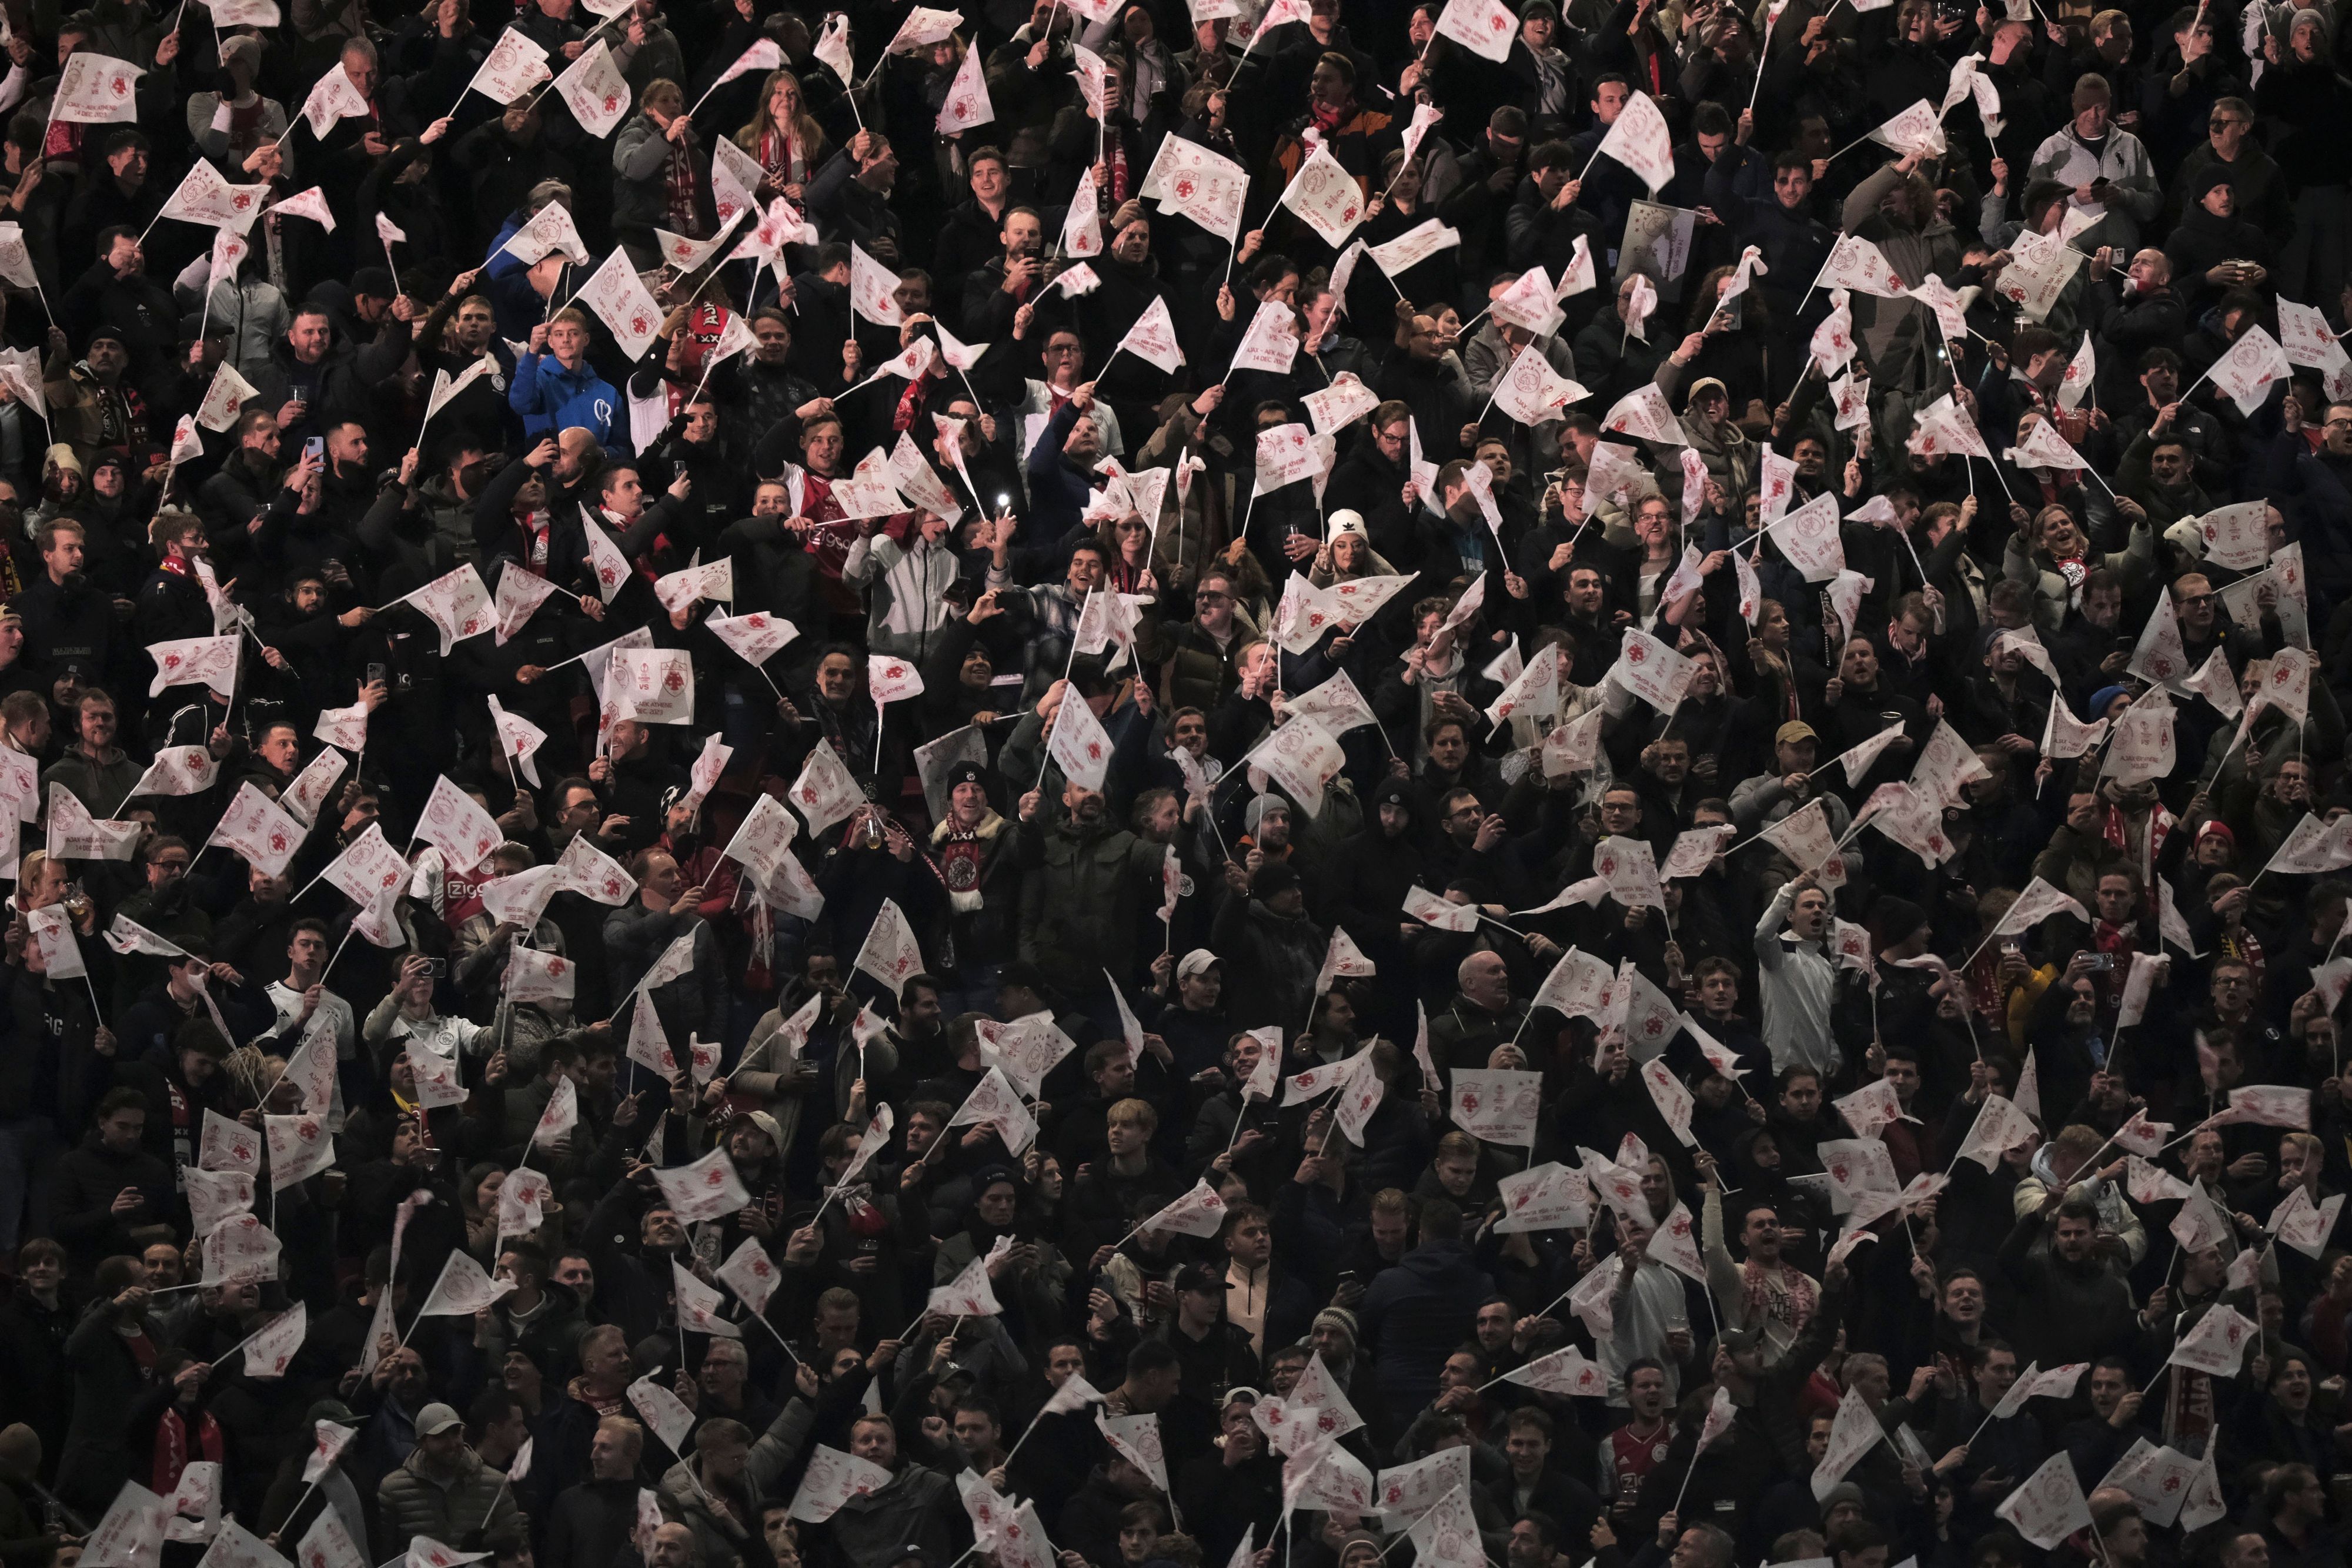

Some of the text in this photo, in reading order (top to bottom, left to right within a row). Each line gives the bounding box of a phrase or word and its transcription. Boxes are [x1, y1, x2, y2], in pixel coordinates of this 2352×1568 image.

[493, 76, 506, 88] AJAX
[590, 85, 597, 94] VS
[505, 90, 517, 101] DEC
[1324, 200, 1333, 209] VS
[1303, 210, 1312, 220] DEC
[1836, 277, 1850, 287] AJAX
[1514, 397, 1526, 410] AJAX
[911, 489, 922, 499] DEC
[887, 684, 906, 694] ATHENE
[707, 777, 715, 785] VS
[749, 845, 761, 855] AJAX
[866, 948, 880, 960] AJAX
[877, 965, 888, 976] DEC
[308, 1072, 323, 1086] AJAX
[1333, 1484, 1341, 1492] VS
